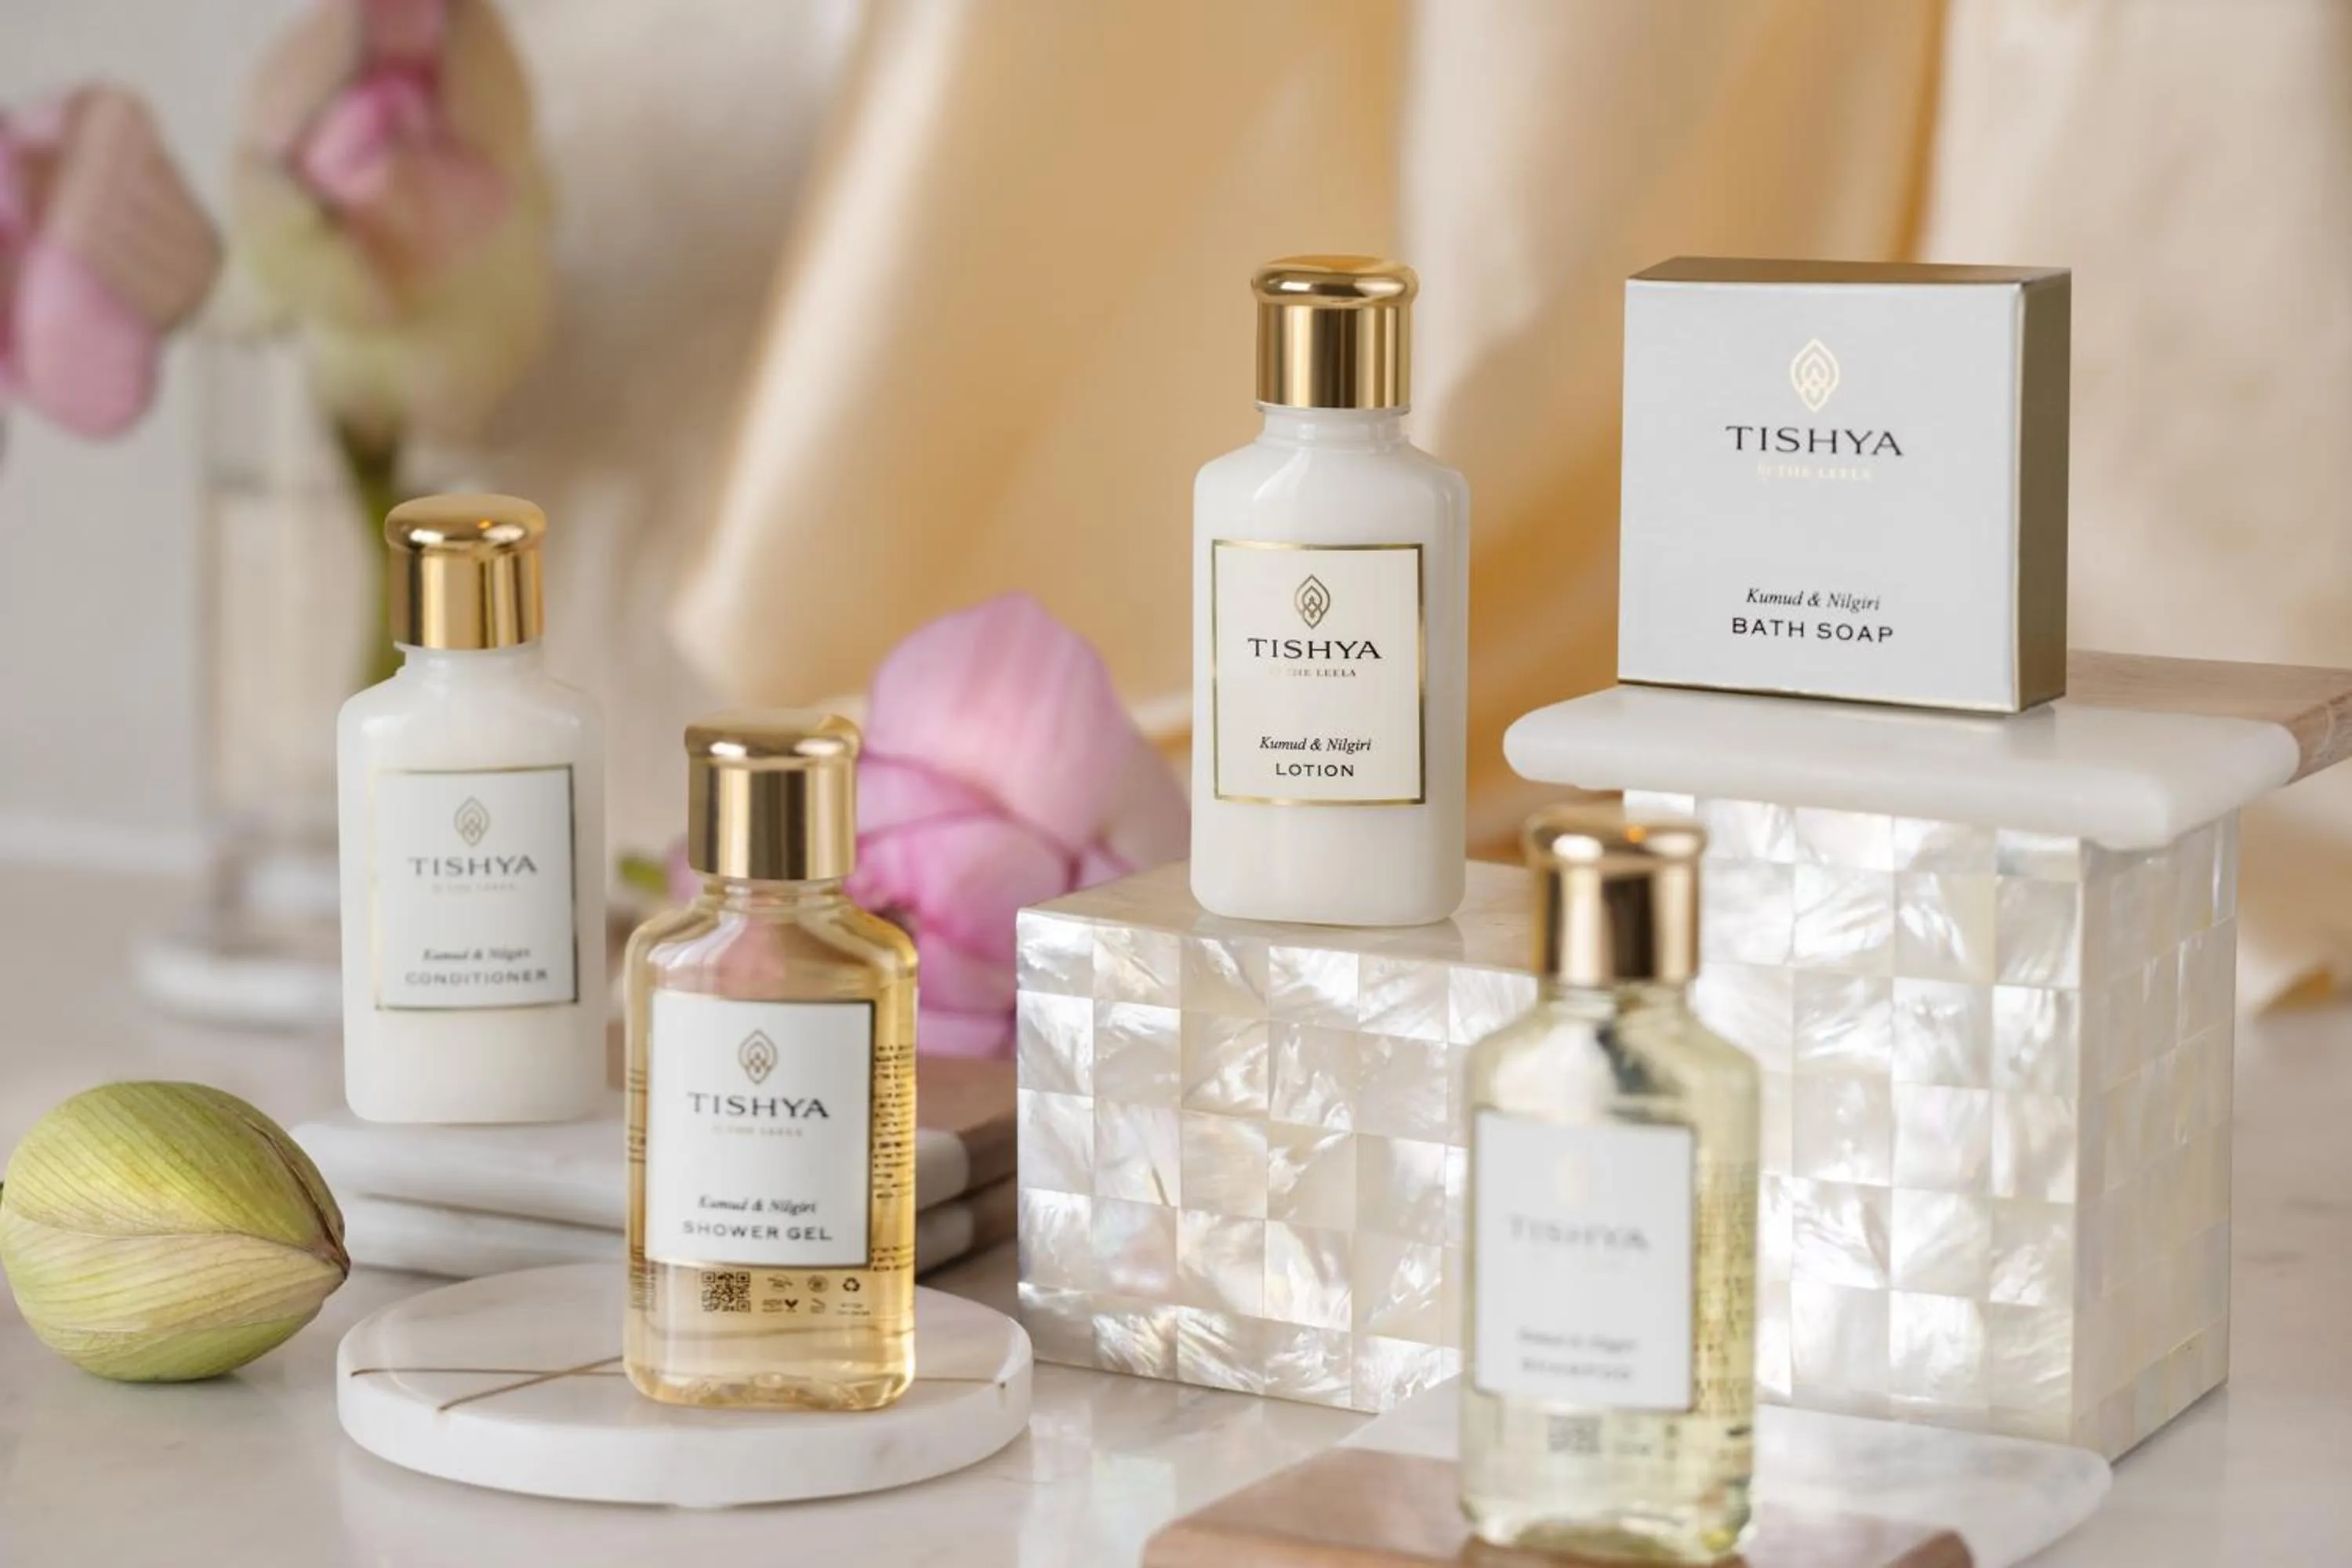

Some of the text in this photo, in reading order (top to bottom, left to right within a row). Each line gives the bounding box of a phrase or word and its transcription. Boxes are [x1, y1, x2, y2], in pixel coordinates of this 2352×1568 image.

[1725, 425, 1904, 456] TISHYA
[1746, 588, 1881, 614] Kumud & Nilgiri
[1731, 617, 1894, 643] BATH SOAP
[1247, 637, 1383, 660] TISHYA
[1258, 736, 1373, 755] Kumud & Nilgiri
[1276, 763, 1355, 778] LOTION
[408, 855, 539, 877] TISHYA
[404, 967, 550, 987] CONDITIONER
[688, 1092, 829, 1120] TISHYA
[751, 1198, 764, 1213] &
[682, 1220, 834, 1242] SHOWER GEL
